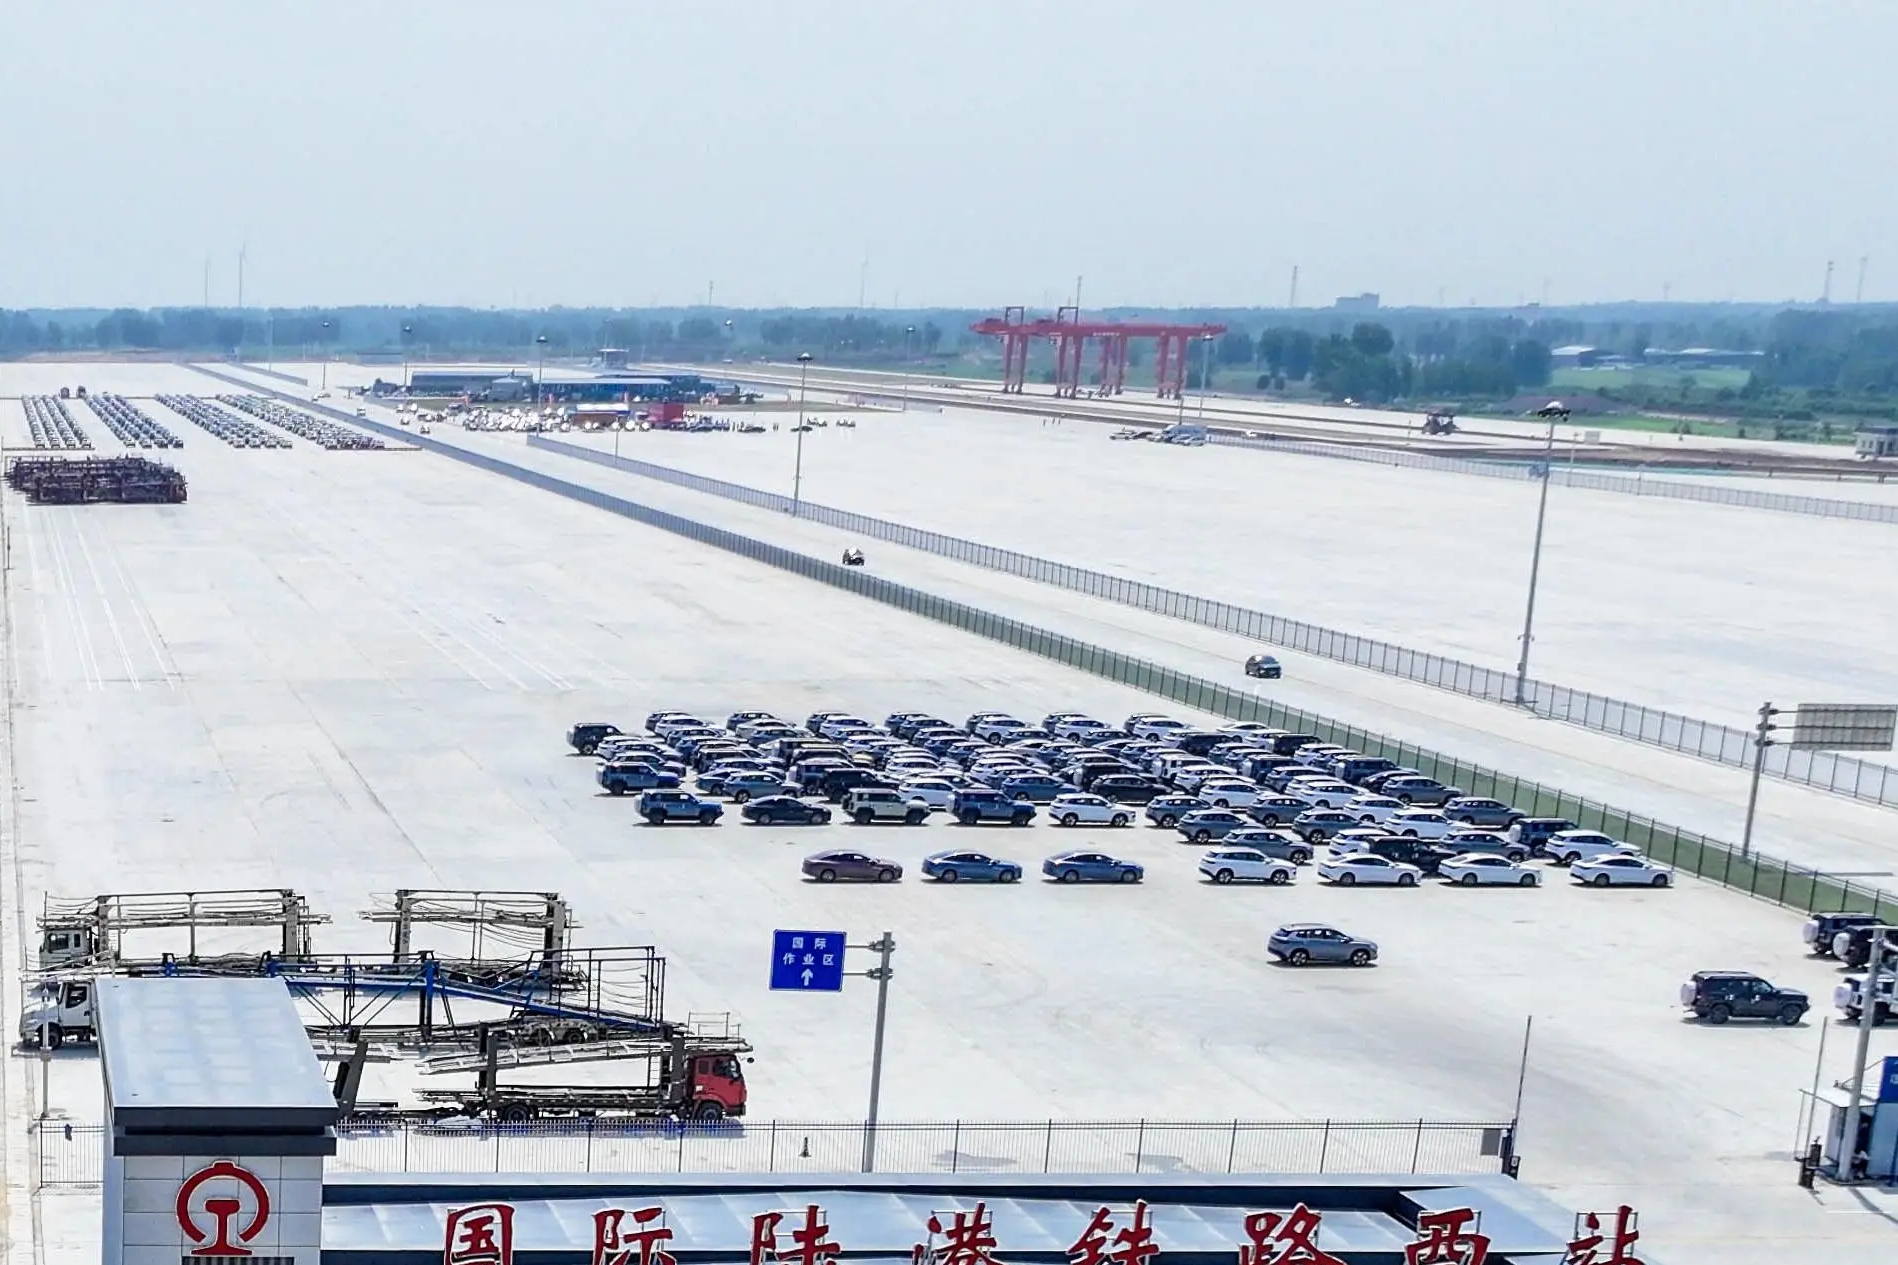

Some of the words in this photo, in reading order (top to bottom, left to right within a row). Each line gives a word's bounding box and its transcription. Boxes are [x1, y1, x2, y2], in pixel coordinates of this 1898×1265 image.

[792, 937, 826, 949] 国际
[783, 953, 834, 965] 作业区
